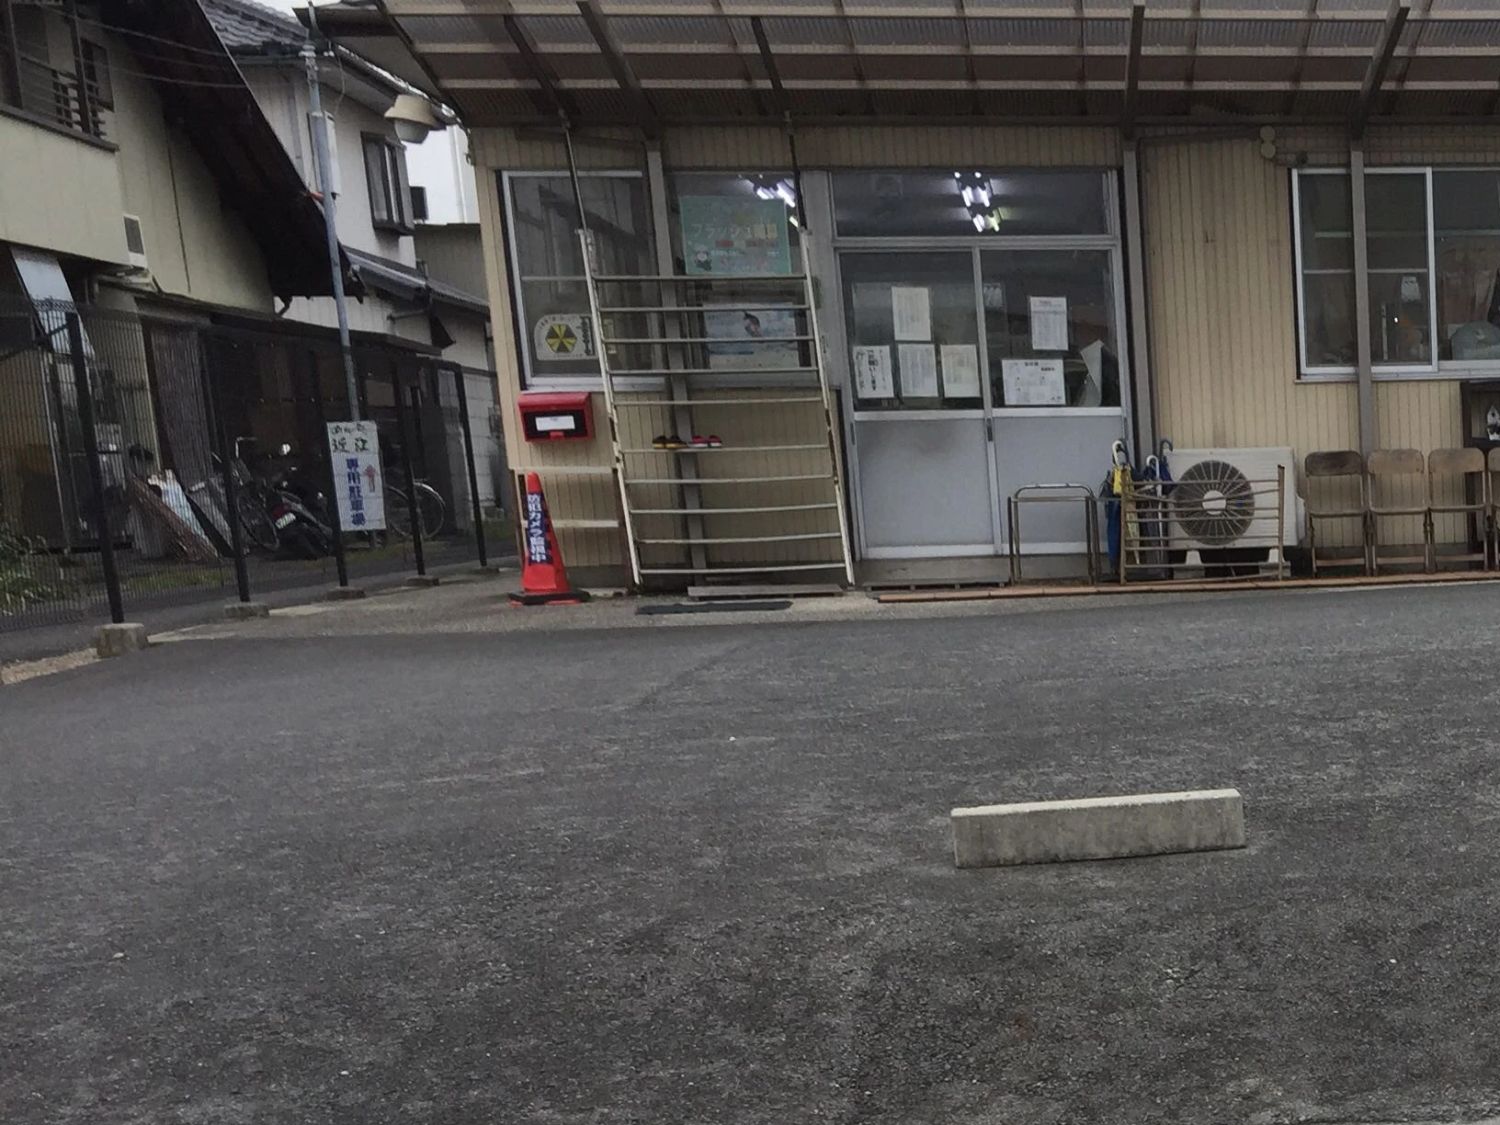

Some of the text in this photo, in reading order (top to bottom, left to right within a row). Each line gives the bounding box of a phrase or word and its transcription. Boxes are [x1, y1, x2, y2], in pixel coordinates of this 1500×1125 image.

[346, 458, 366, 526] 専用駐車場
[527, 494, 547, 563] 防犯カメラ監視中
